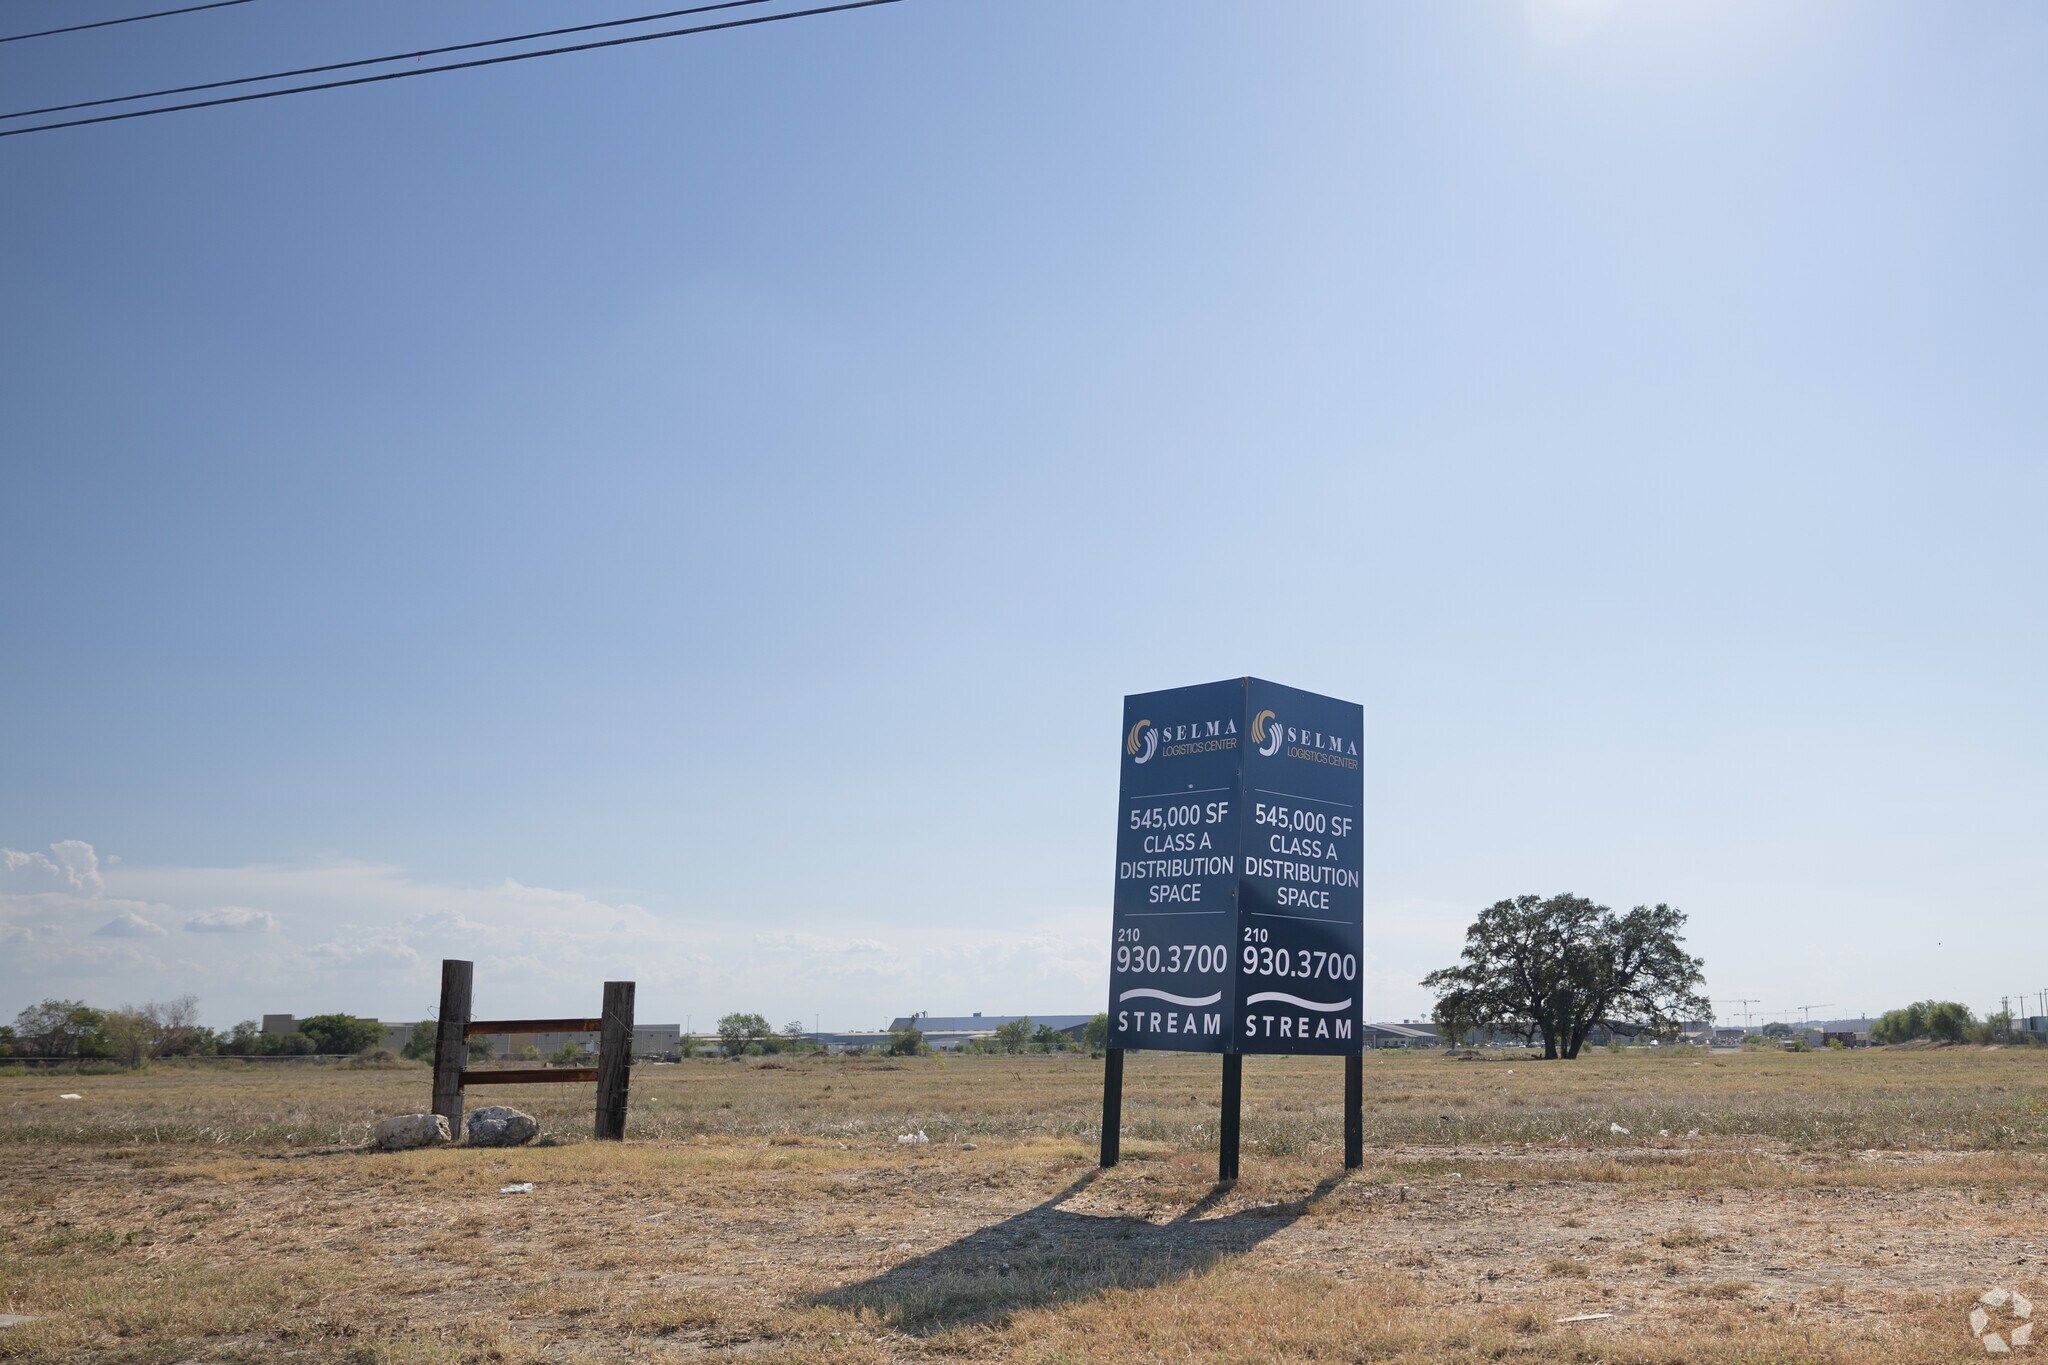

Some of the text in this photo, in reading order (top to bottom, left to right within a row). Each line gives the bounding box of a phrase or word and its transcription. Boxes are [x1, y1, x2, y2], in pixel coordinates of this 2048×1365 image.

[1162, 718, 1237, 742] SELMA
[1288, 727, 1358, 756] SELMA
[1163, 738, 1237, 757] LOGISTICS CENTER
[1288, 746, 1358, 769] LOGISTICS CENTER
[1130, 802, 1228, 830] 545,000 SF
[1255, 804, 1352, 837] 545,000 SF
[1144, 832, 1211, 853] CLASS A
[1270, 835, 1338, 860] CLASS A
[1120, 856, 1233, 880] DISTRIBUTION
[1246, 857, 1359, 888] DISTRIBUTION
[1149, 883, 1201, 903] SPACE
[1277, 887, 1329, 910] SPACE
[1118, 928, 1140, 942] 210
[1244, 927, 1268, 942] 210
[1117, 944, 1228, 973] 930.3700
[1243, 946, 1356, 981] 930.3700
[1118, 1010, 1220, 1035] STREAM
[1246, 1015, 1351, 1039] STREAM
